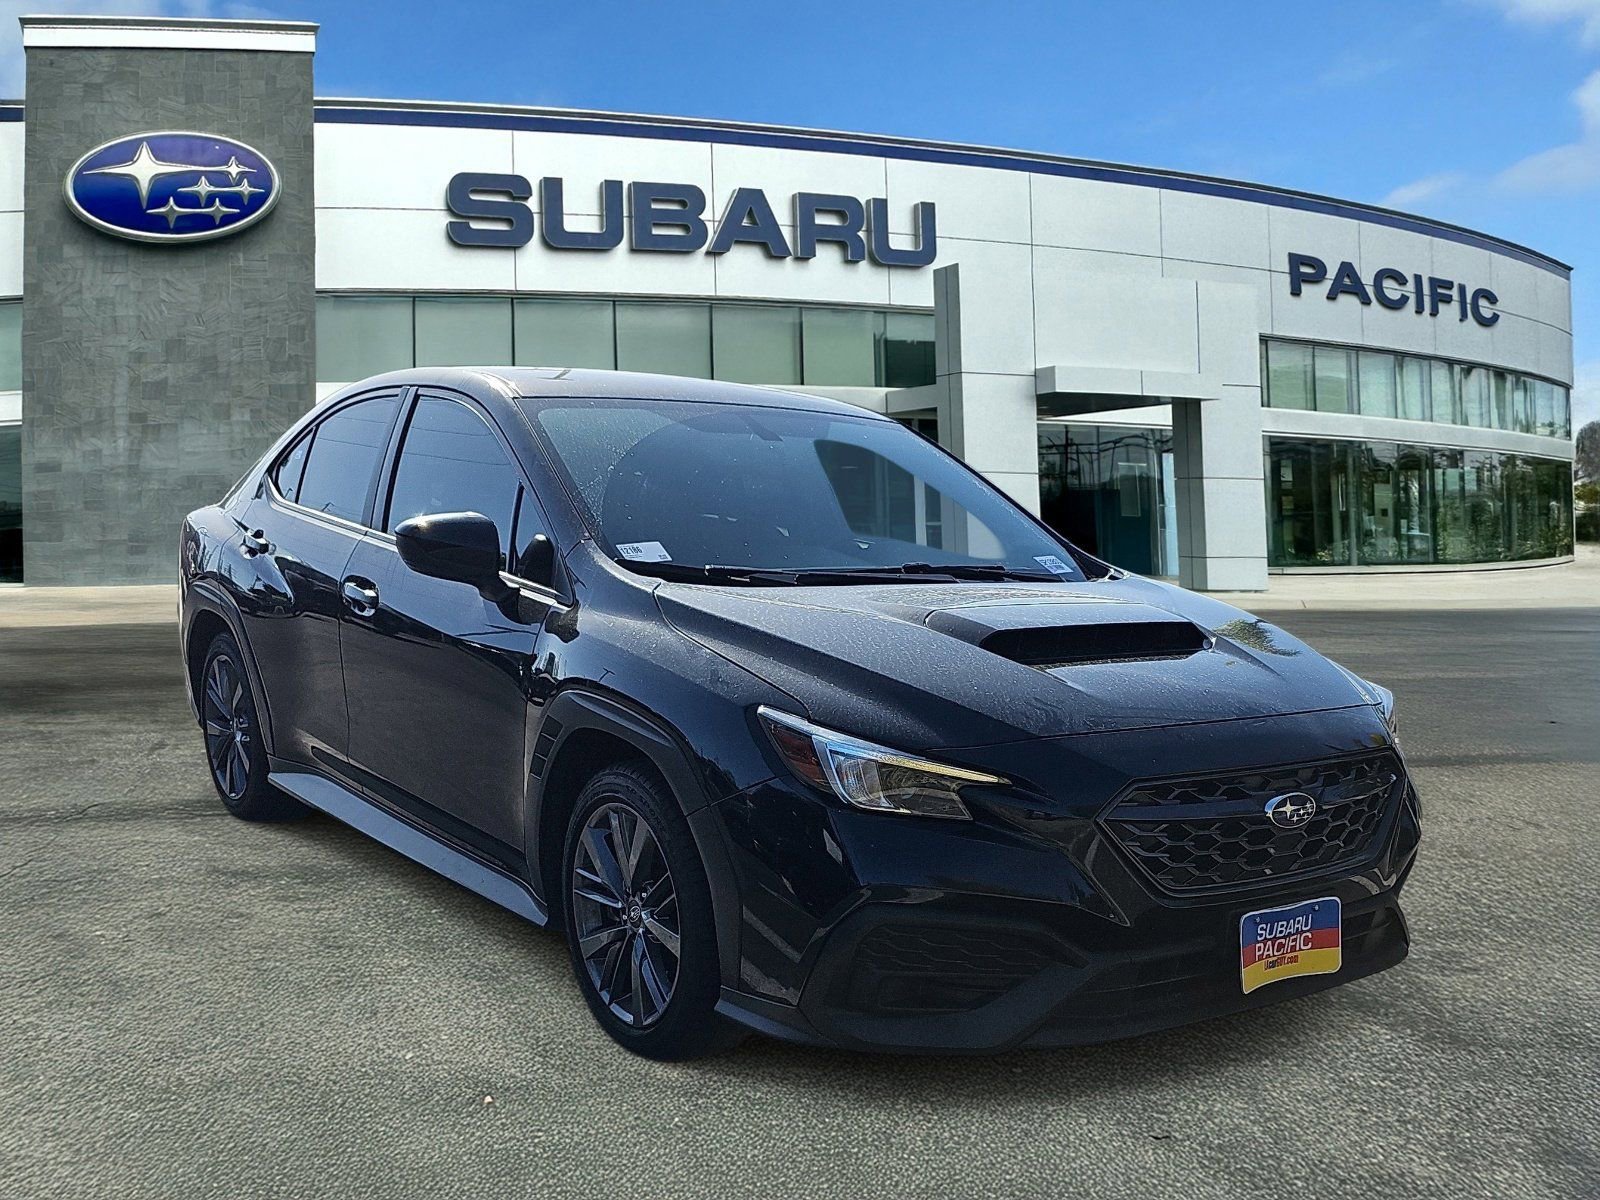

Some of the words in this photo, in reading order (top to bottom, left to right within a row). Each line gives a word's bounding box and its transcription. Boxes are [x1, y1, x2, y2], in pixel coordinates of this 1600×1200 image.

[446, 171, 937, 268] SUBARU
[1288, 251, 1500, 327] PACIFIC
[1255, 931, 1312, 962] PACIFIC
[1257, 914, 1312, 940] SUBARU
